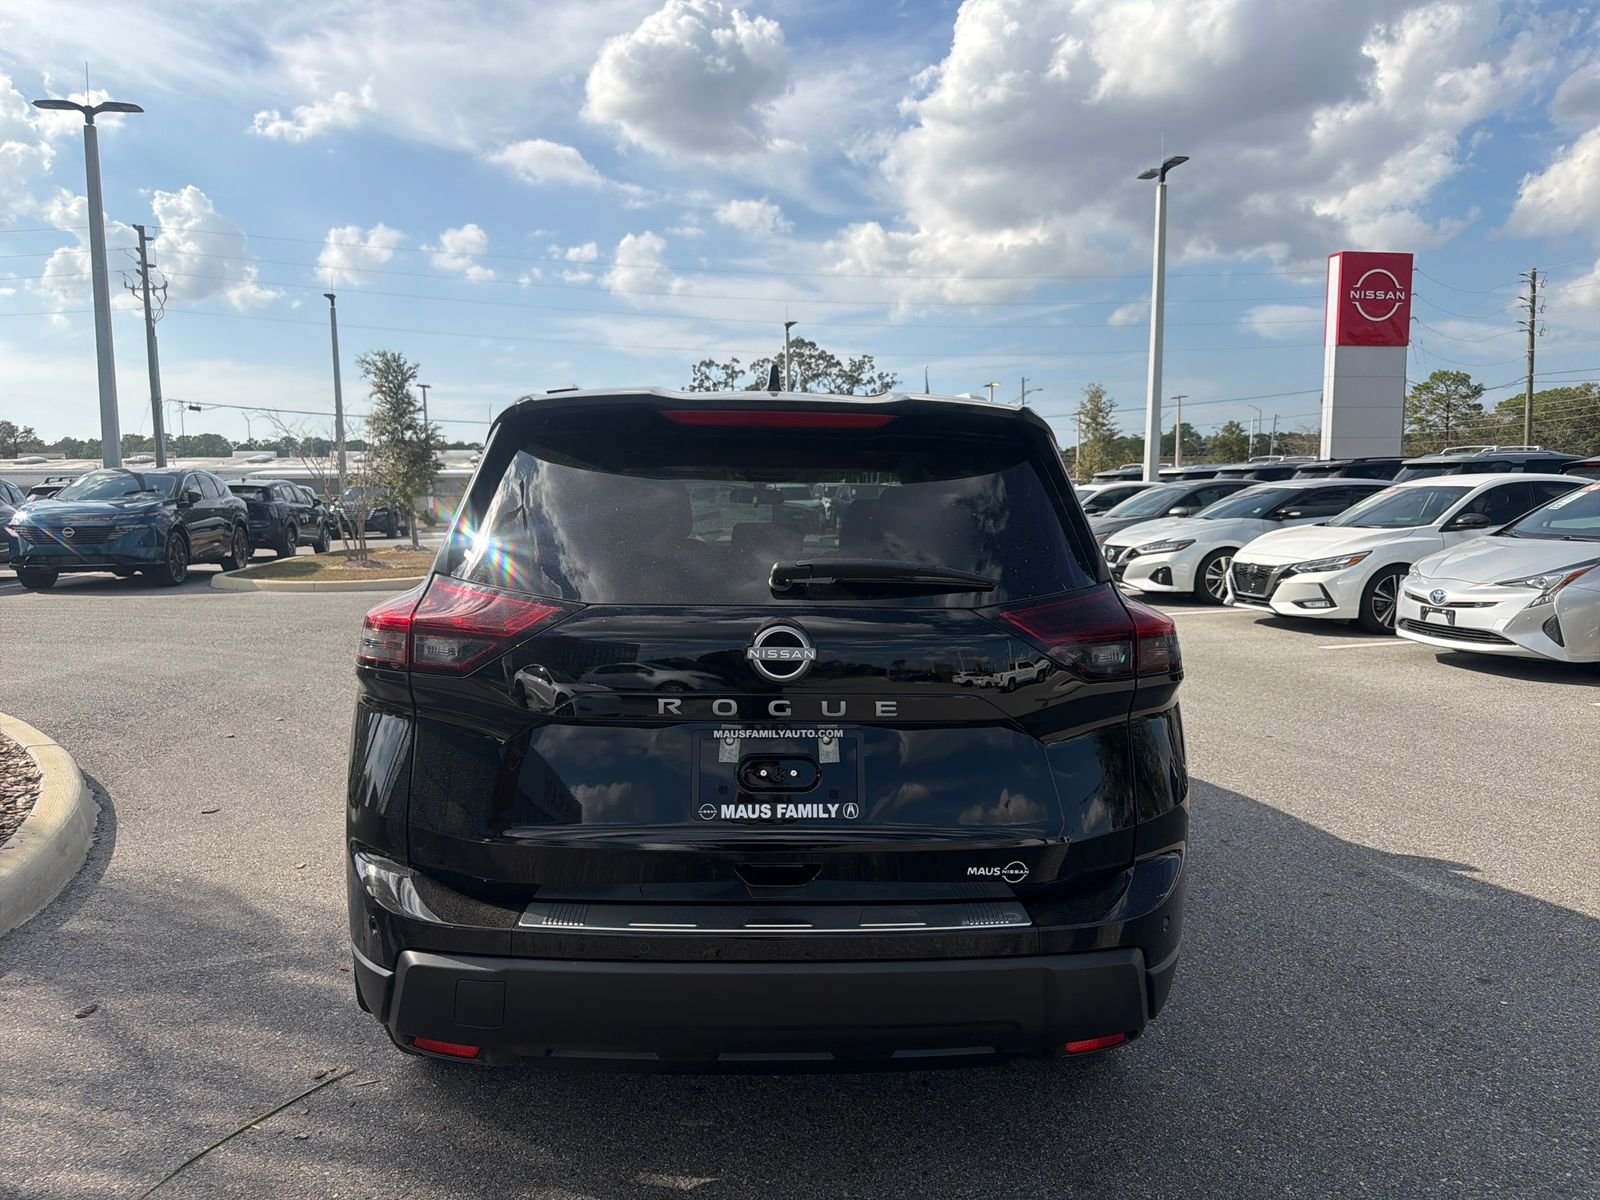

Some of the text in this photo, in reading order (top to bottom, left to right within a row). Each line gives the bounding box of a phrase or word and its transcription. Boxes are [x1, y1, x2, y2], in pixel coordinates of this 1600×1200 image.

[1350, 290, 1405, 300] NISSAN
[749, 649, 814, 658] NISSAN
[657, 698, 898, 717] ROGUE
[713, 729, 844, 738] MAUSFAMILYAUTO.COM
[720, 803, 840, 819] MAUS FAMILY
[966, 867, 1001, 876] MAUS
